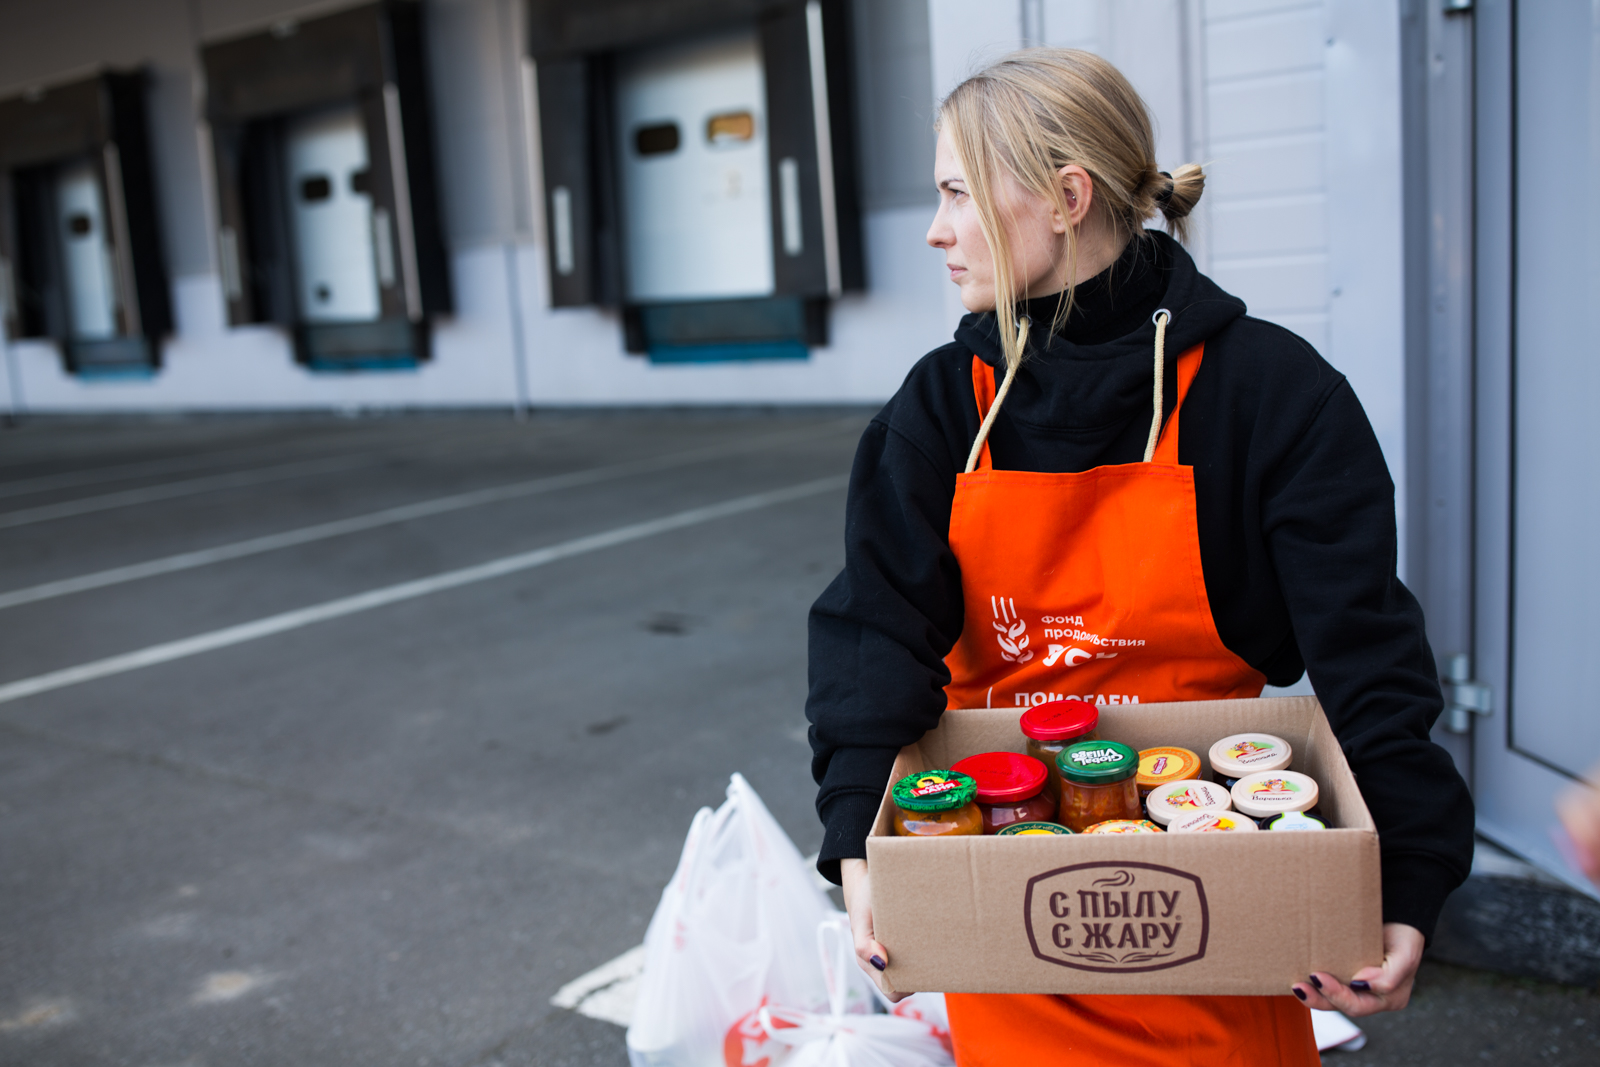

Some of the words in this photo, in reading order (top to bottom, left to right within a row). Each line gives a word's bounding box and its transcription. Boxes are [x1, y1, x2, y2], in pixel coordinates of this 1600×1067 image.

[1071, 747, 1118, 760] Village
[1073, 753, 1124, 766] Global
[918, 783, 956, 795] ВАНЯ
[1049, 891, 1070, 918] С
[1077, 889, 1181, 918] ПЫЛУ
[1052, 923, 1073, 949] С
[1081, 922, 1182, 949] ЖАРУ
